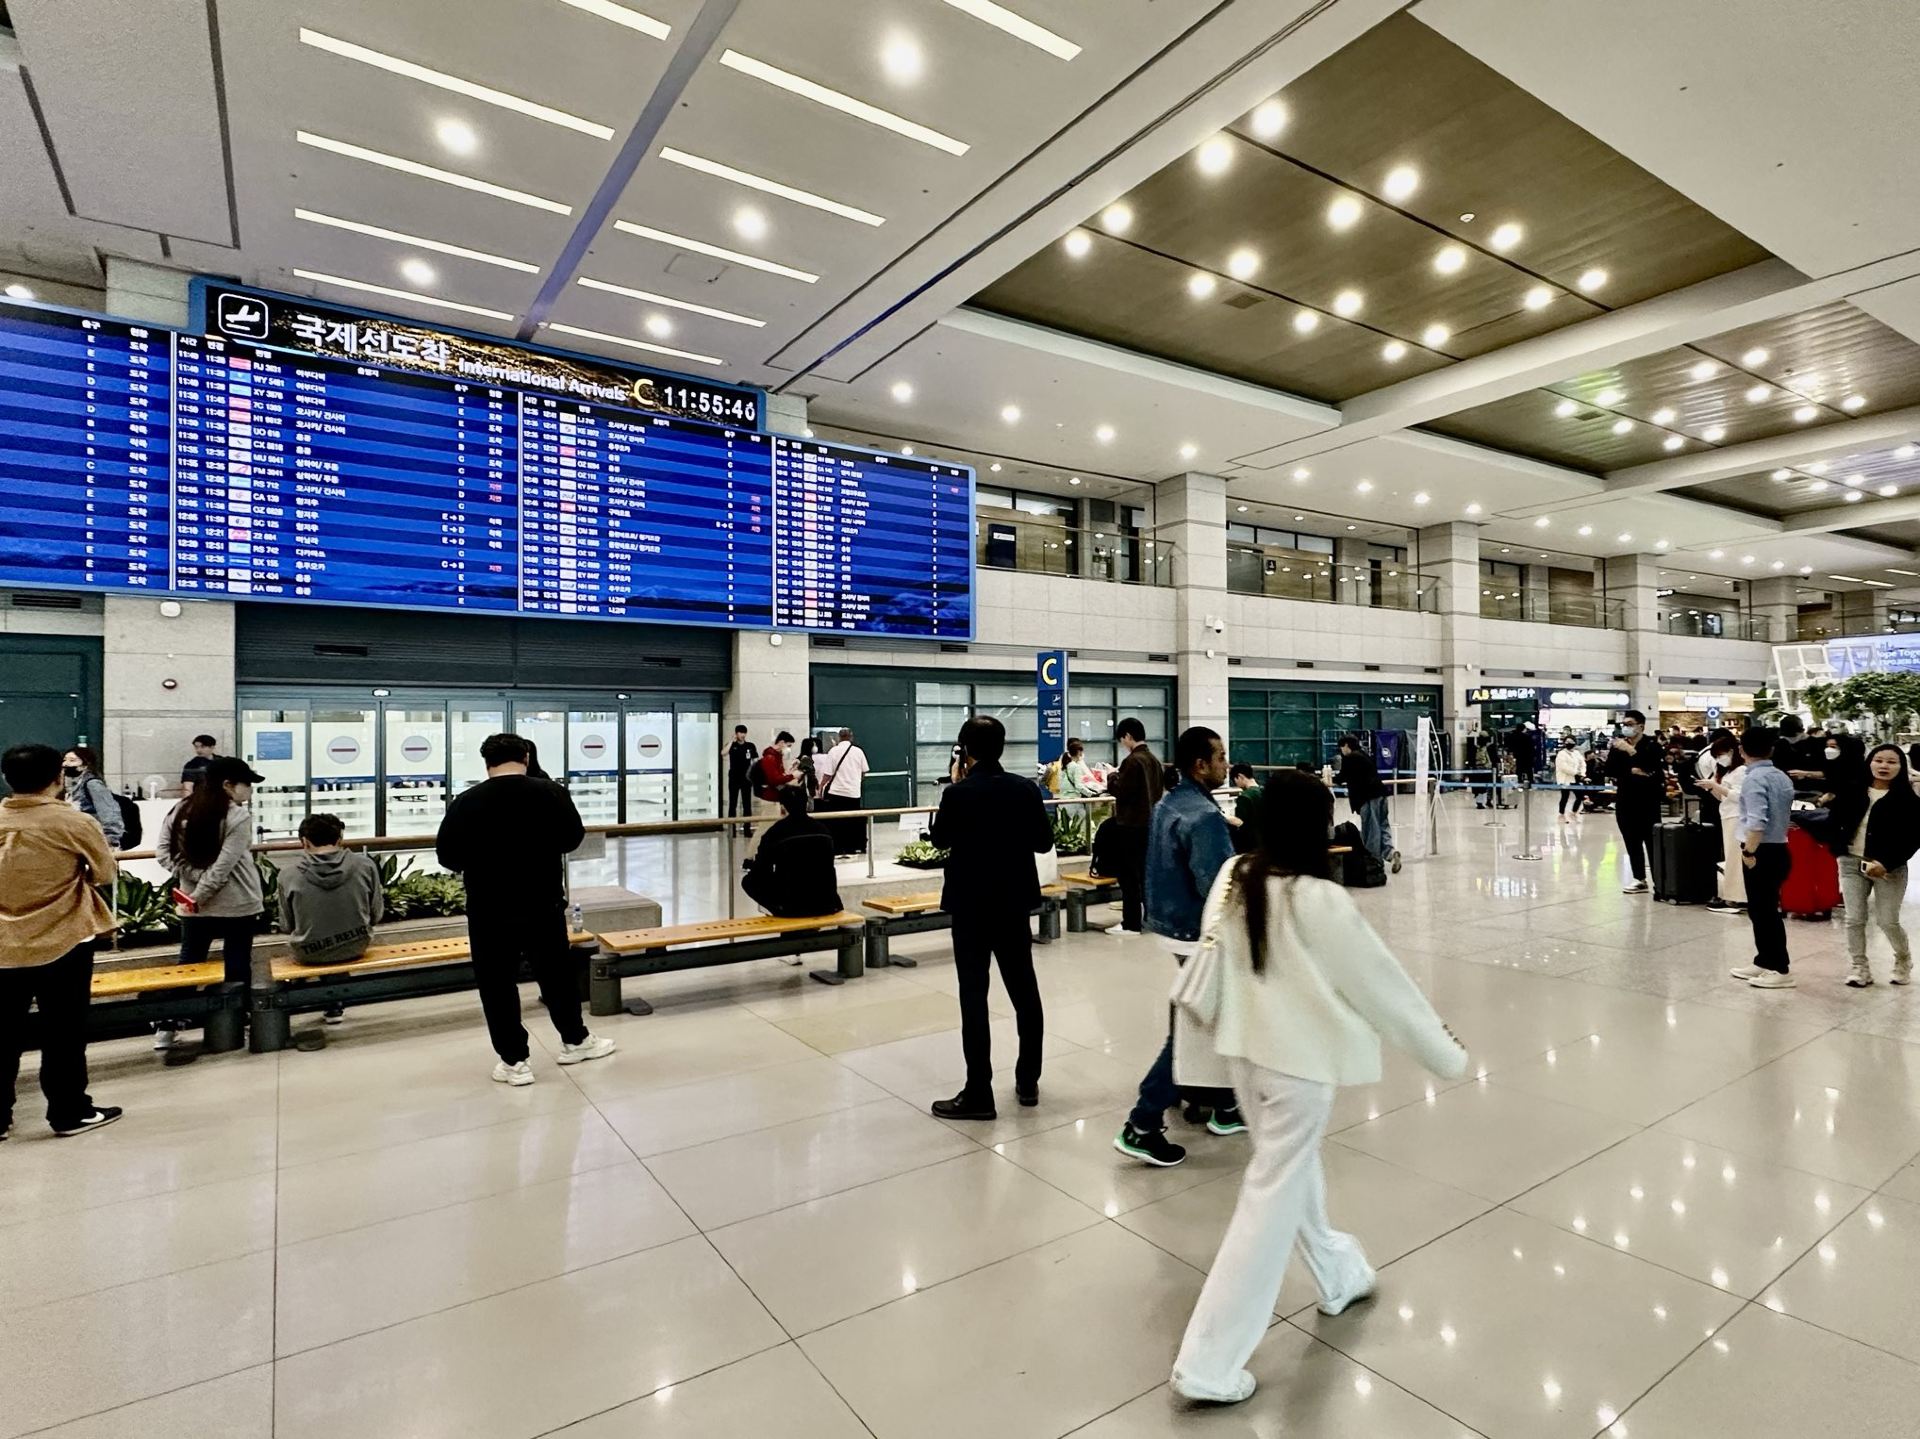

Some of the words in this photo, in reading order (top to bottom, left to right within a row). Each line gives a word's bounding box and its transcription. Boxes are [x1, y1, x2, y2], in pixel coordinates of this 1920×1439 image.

[88, 335, 95, 343] E
[130, 341, 148, 352] 도착
[87, 348, 95, 357] E
[129, 356, 148, 366] 도착
[290, 314, 450, 370] 국제선도착
[458, 358, 566, 392] International
[568, 378, 628, 402] Arrivals
[634, 378, 654, 406] C
[88, 362, 94, 371] E
[130, 369, 148, 379] 도착
[254, 375, 268, 384] WY
[130, 383, 148, 393] 도착
[87, 391, 94, 399] E
[129, 397, 148, 407] 도착
[129, 410, 148, 420] 도착
[254, 428, 266, 436] UO
[254, 440, 266, 449] CX
[86, 461, 95, 469] C
[129, 466, 148, 475] 도착
[87, 475, 94, 484] E
[129, 480, 148, 489] 도착
[254, 480, 265, 488] RS
[266, 481, 279, 489] 712
[87, 489, 94, 497] E
[129, 494, 148, 503] 도착
[253, 493, 266, 501] CA
[128, 507, 148, 517] 도착
[253, 506, 265, 514] OZ
[129, 521, 147, 530] 도착
[128, 535, 147, 544] 도착
[86, 546, 94, 554] E
[128, 549, 147, 557] 도착
[205, 541, 224, 550] 12:51
[253, 545, 265, 553] RS
[266, 546, 279, 554] 742
[86, 559, 94, 568] E
[128, 562, 147, 571] 도착
[86, 573, 93, 582] E
[128, 576, 147, 585] 도착
[253, 571, 266, 579] CX
[1042, 658, 1058, 686] C
[301, 936, 334, 955] TRUE
